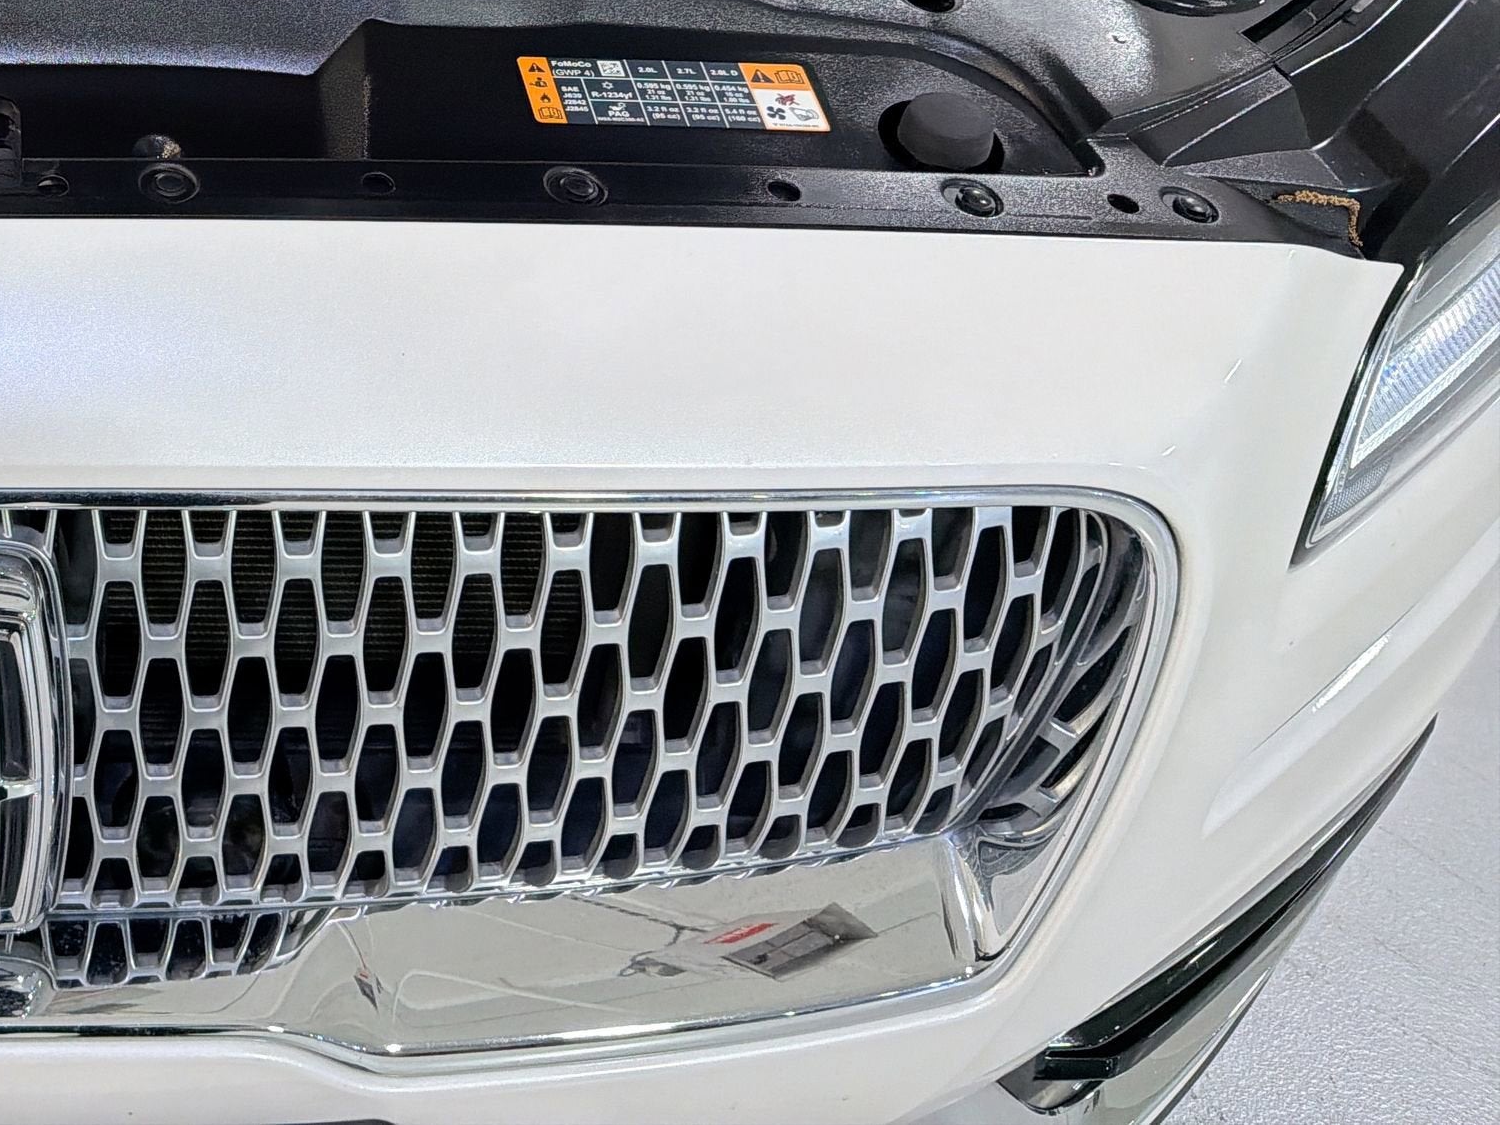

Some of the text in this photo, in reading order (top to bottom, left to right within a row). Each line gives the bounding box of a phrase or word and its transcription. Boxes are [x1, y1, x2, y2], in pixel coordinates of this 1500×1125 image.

[583, 69, 595, 77] 4)
[660, 83, 671, 91] kg
[699, 84, 711, 92] kg
[737, 85, 749, 94] kg
[591, 90, 633, 99] R-1234yf
